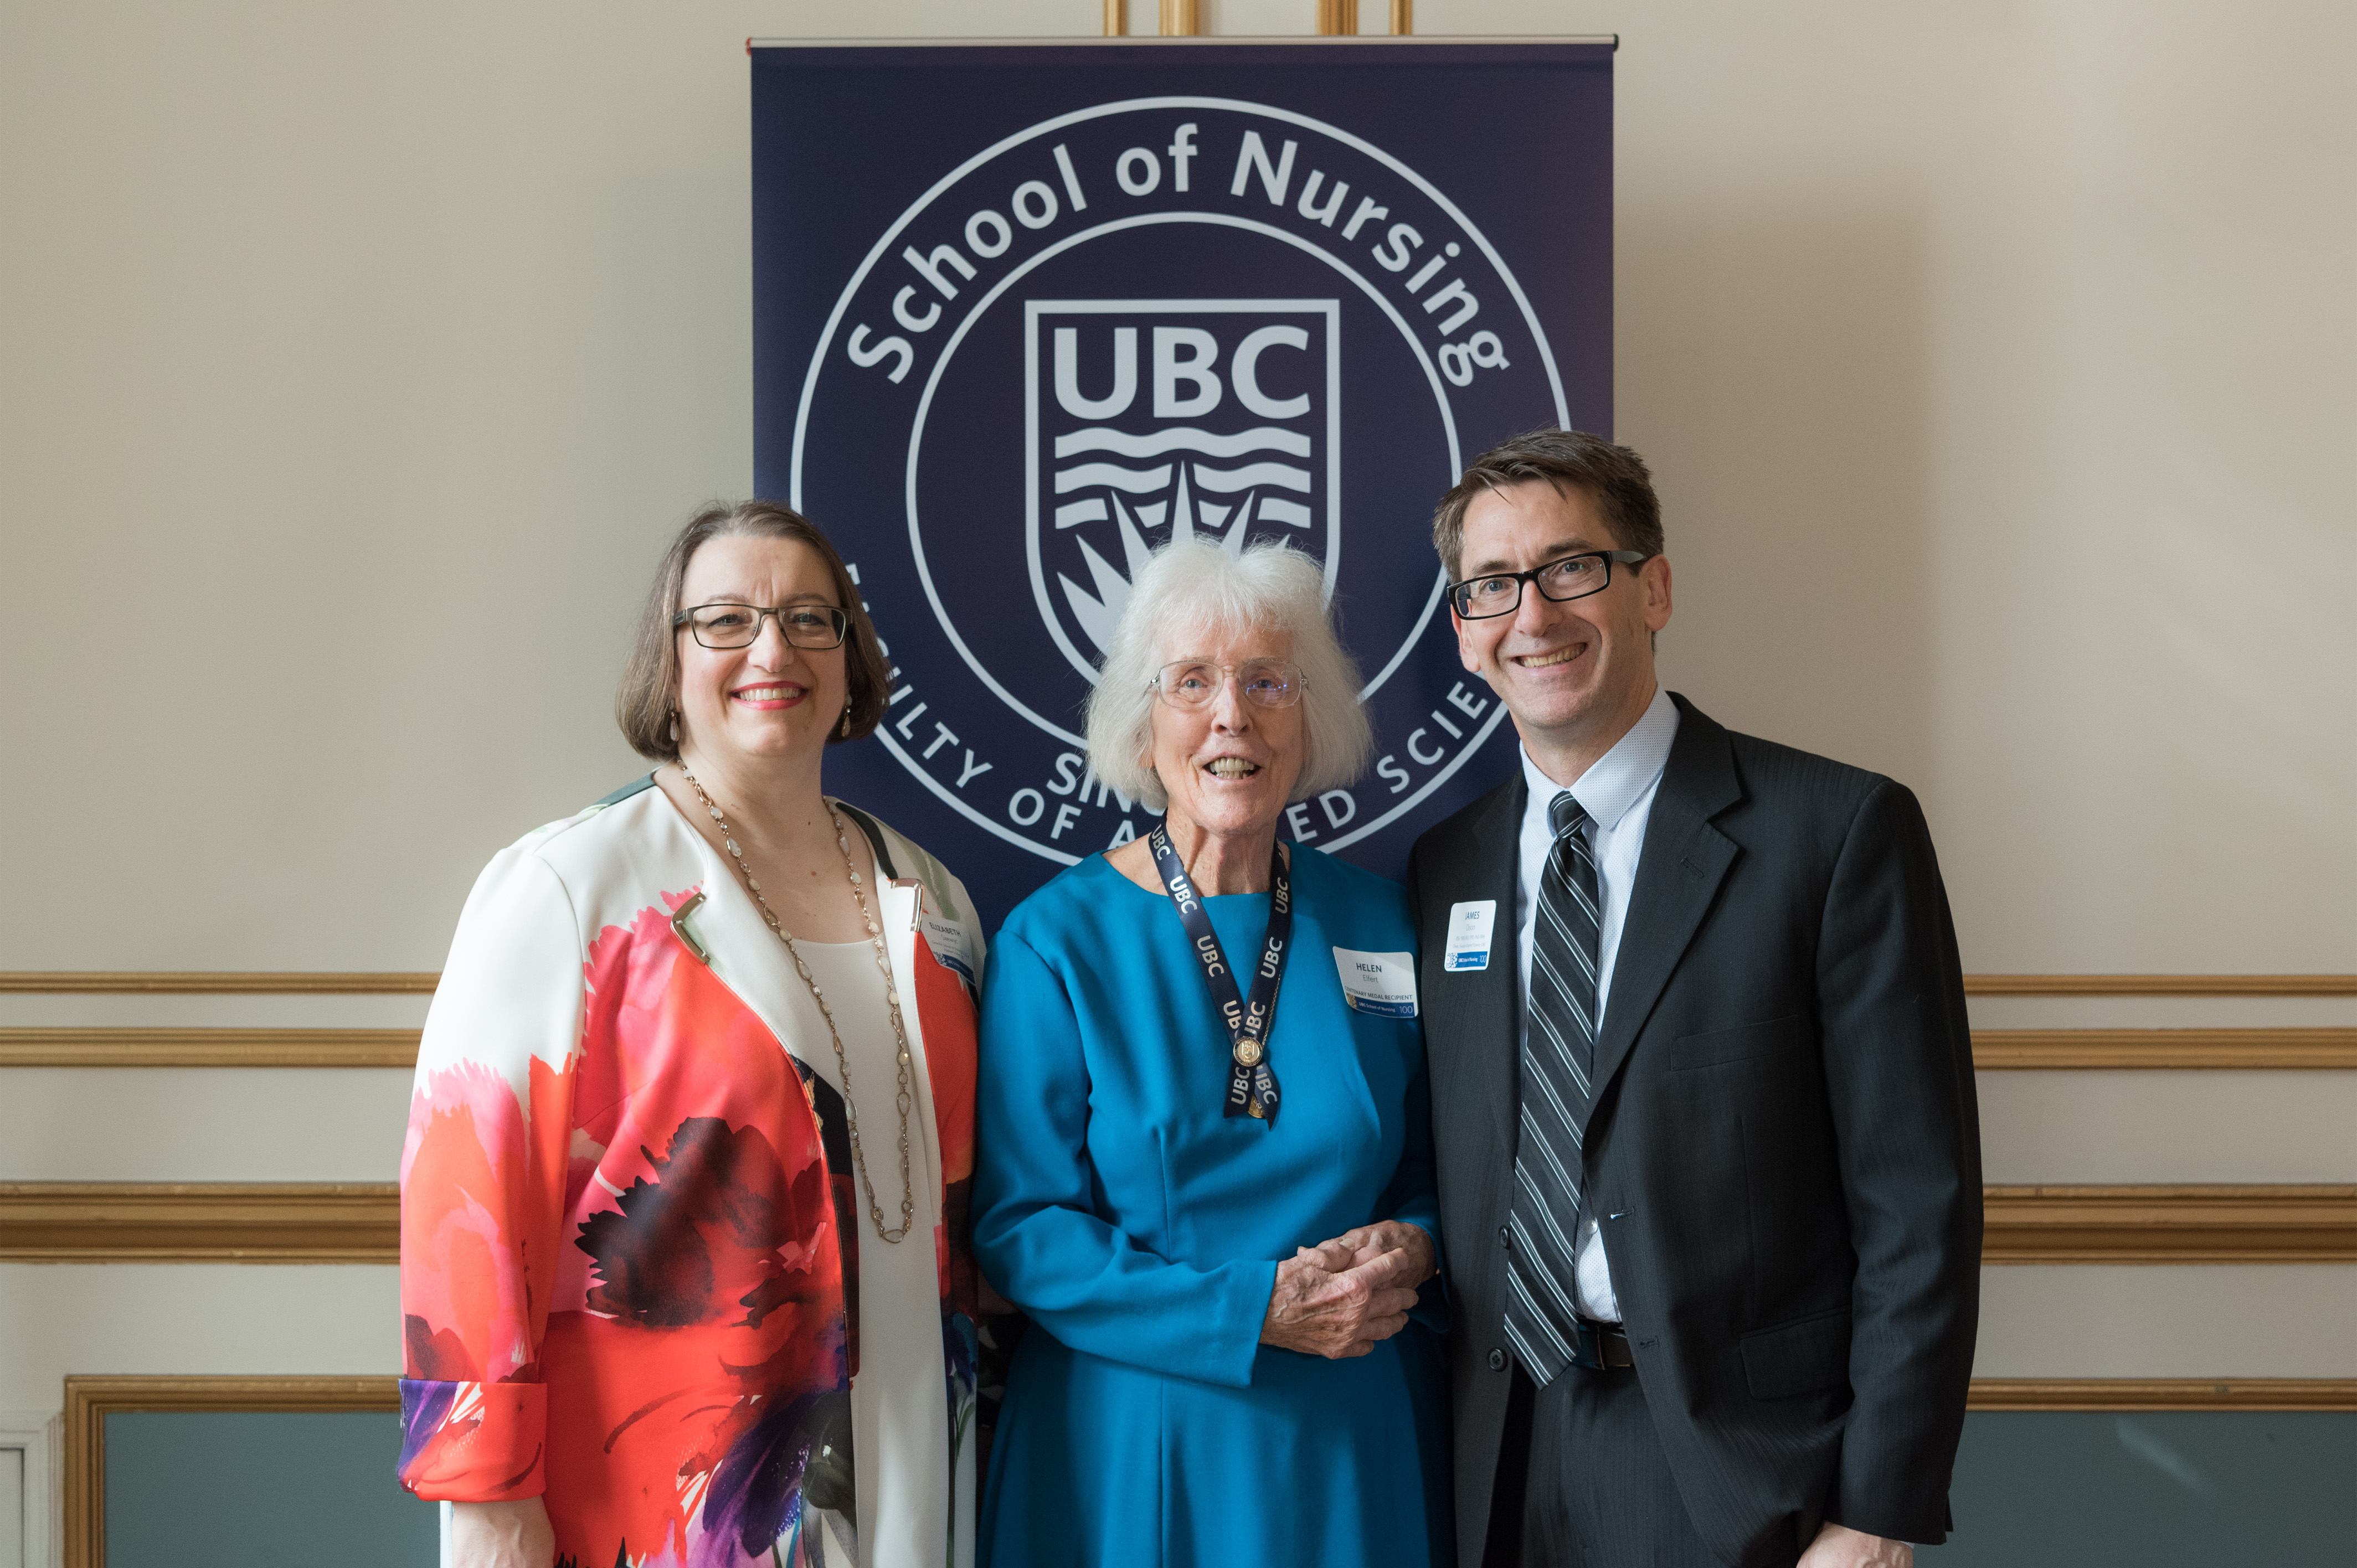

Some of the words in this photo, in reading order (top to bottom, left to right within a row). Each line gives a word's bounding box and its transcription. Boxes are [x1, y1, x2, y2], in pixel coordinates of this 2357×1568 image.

[847, 143, 1087, 384] School
[1116, 123, 1198, 196] of
[1231, 130, 1510, 386] Nursing
[1054, 325, 1310, 420] UBC
[1008, 788, 1082, 839] OF
[1377, 681, 1488, 794] SCIE
[1151, 824, 1171, 860] UBC
[1170, 875, 1198, 914] UBC
[1275, 877, 1288, 914] UBC
[929, 922, 961, 937] ELIZABETH
[1465, 911, 1480, 920] JAMES
[1197, 935, 1224, 978] UBC
[1260, 937, 1283, 978] UBC
[1356, 963, 1382, 973] HELEN
[1345, 986, 1367, 997] CENTENARY
[1399, 1005, 1413, 1014] 100
[1223, 1000, 1242, 1039] UB
[1231, 1066, 1250, 1105] UBC
